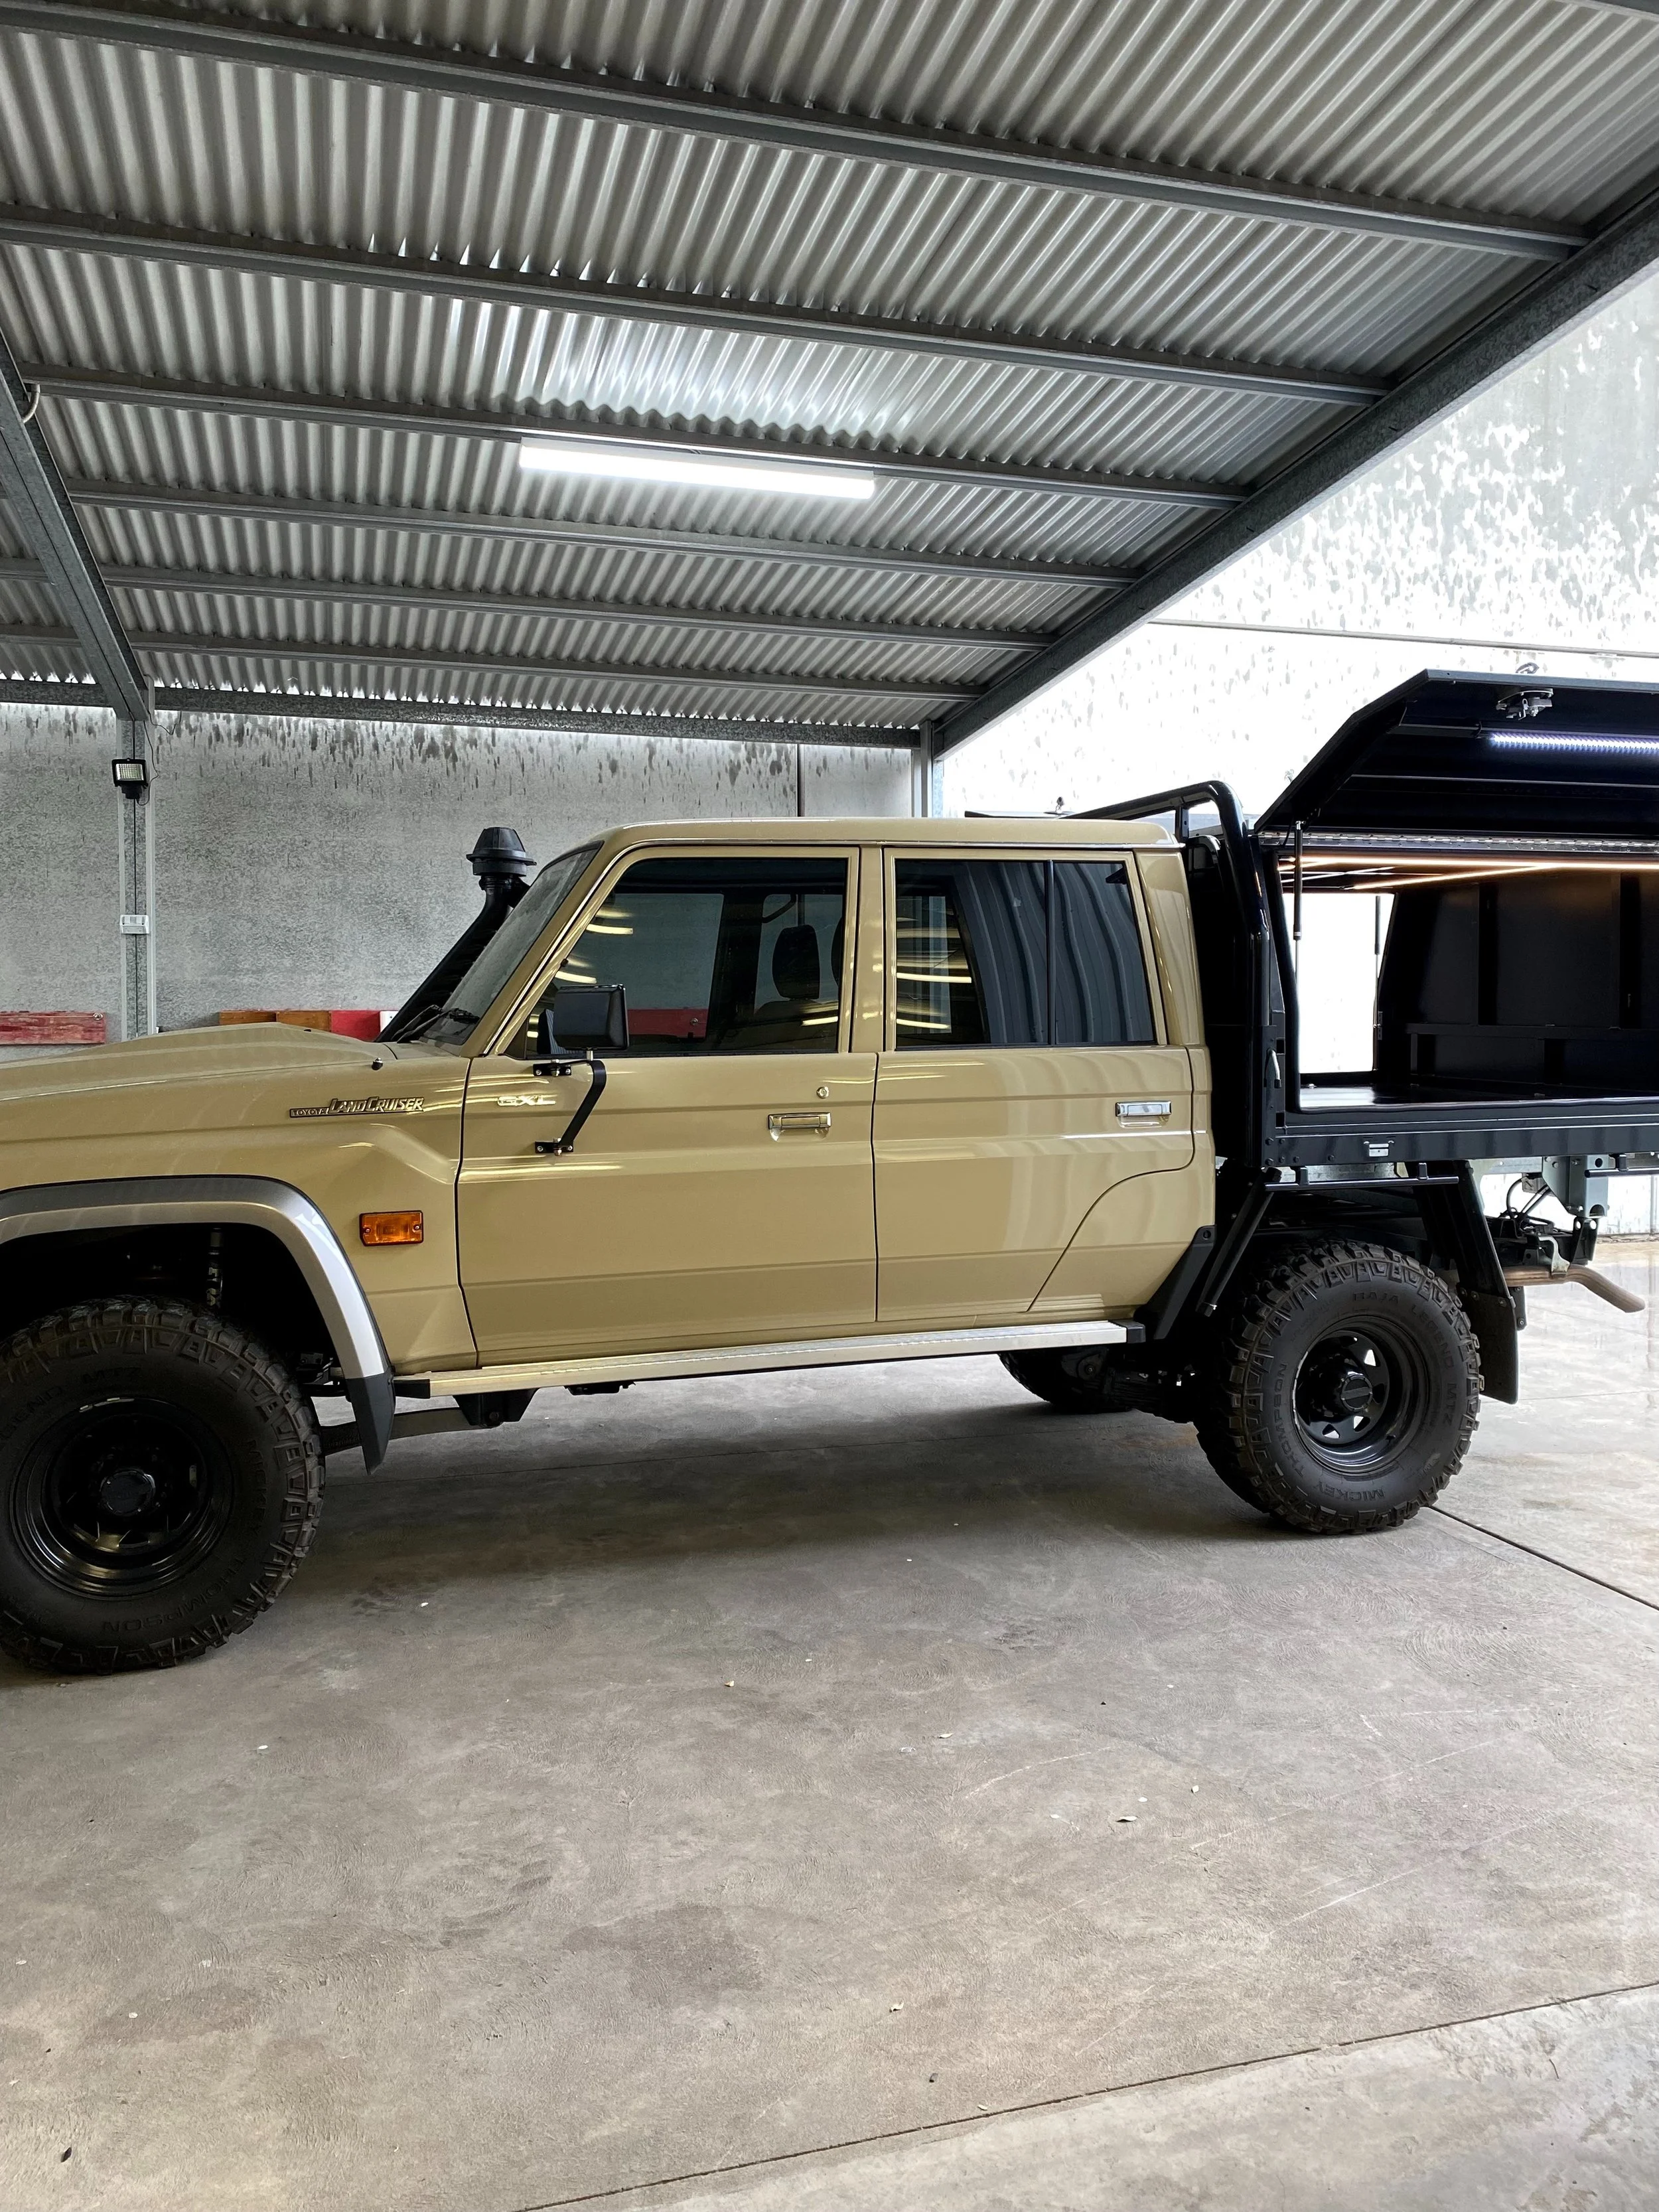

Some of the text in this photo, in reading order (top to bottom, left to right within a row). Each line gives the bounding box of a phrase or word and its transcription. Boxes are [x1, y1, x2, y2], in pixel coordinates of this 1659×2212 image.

[292, 1108, 327, 1116] TOYOTA
[498, 1096, 556, 1107] GXL
[1352, 1291, 1400, 1305] BAJA
[1411, 1305, 1455, 1368] LEGEND
[1273, 1363, 1386, 1502] MICKEY THOMPSON
[102, 1554, 247, 1632] THOMPSON
